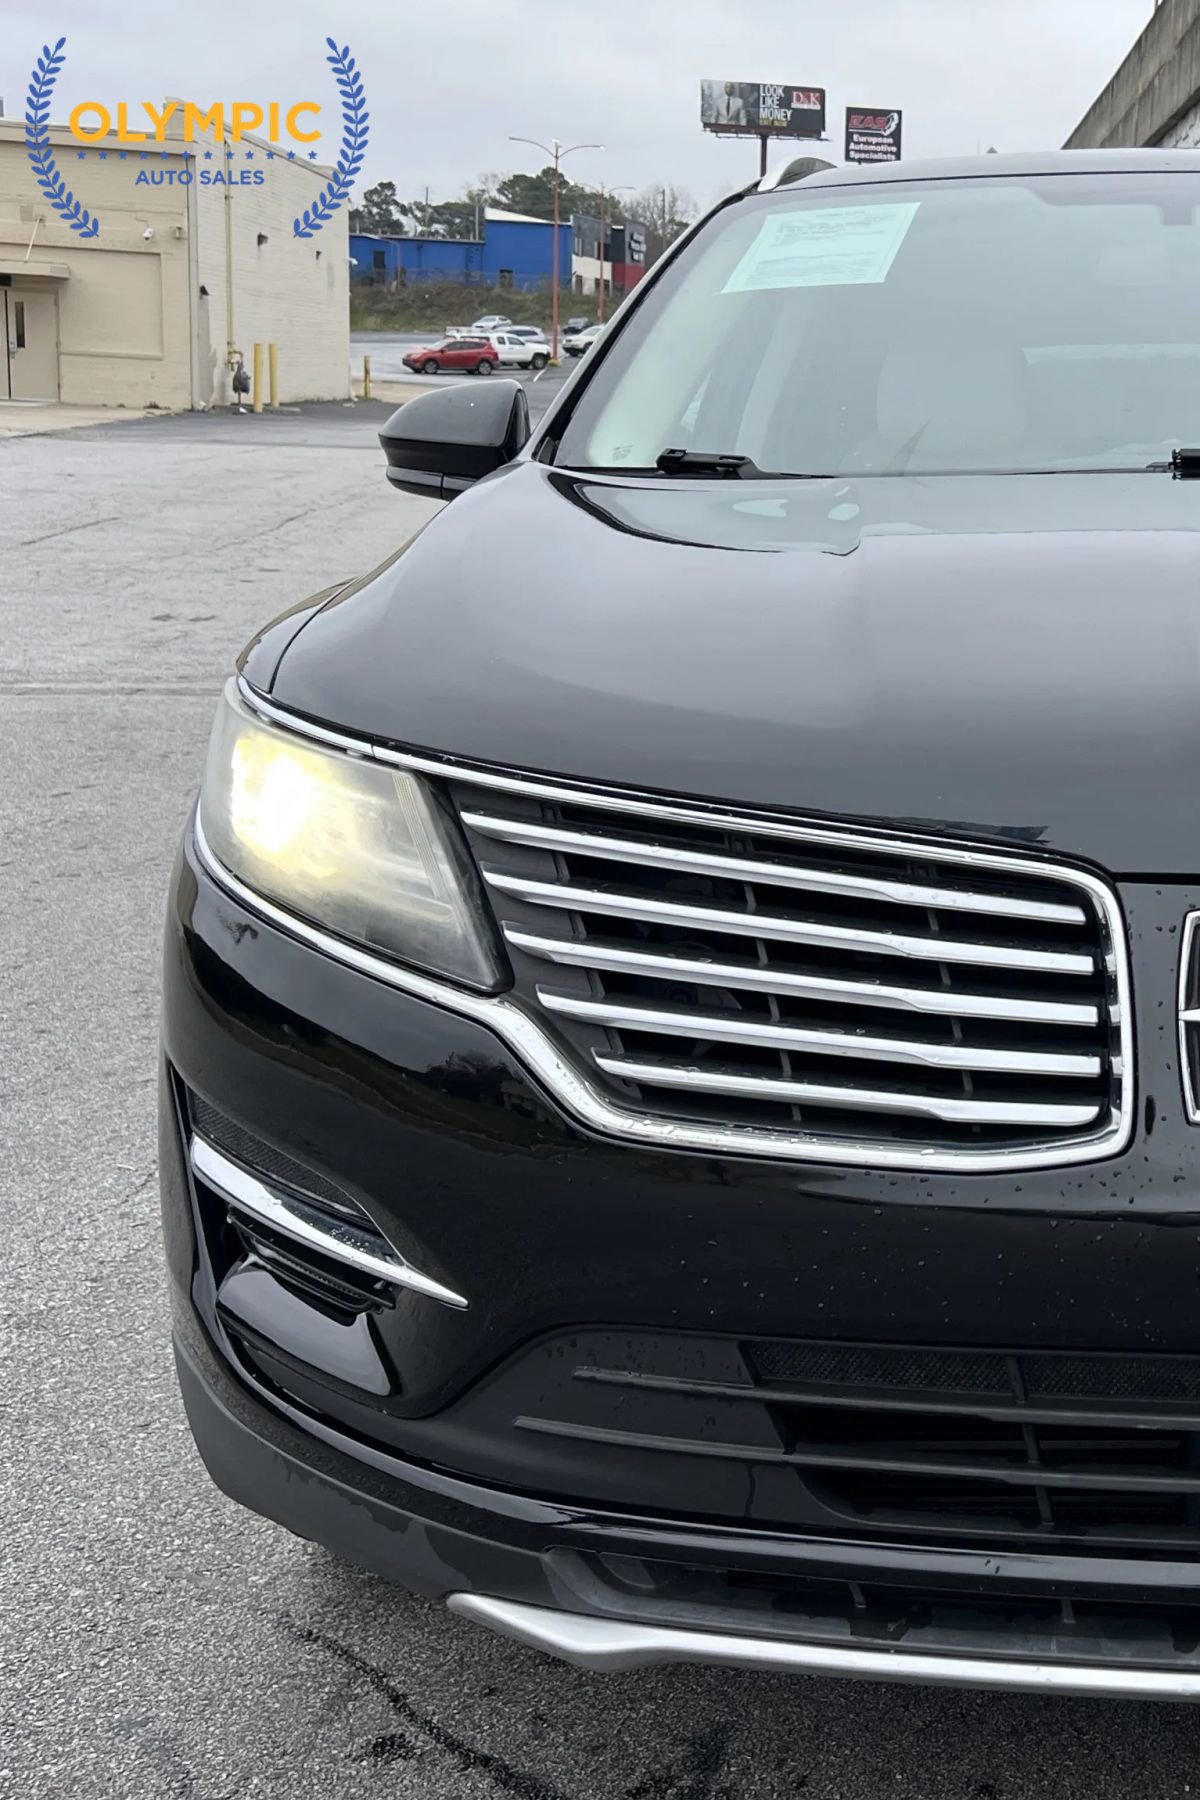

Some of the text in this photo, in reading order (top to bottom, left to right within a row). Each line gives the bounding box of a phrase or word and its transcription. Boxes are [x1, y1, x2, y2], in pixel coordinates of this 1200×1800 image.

[759, 84, 785, 97] LOOK
[759, 96, 780, 108] LIKE
[759, 107, 793, 121] MONEY
[848, 115, 888, 129] EAS
[852, 134, 894, 144] European
[849, 142, 897, 152] Automotive
[849, 151, 896, 160] Specialists
